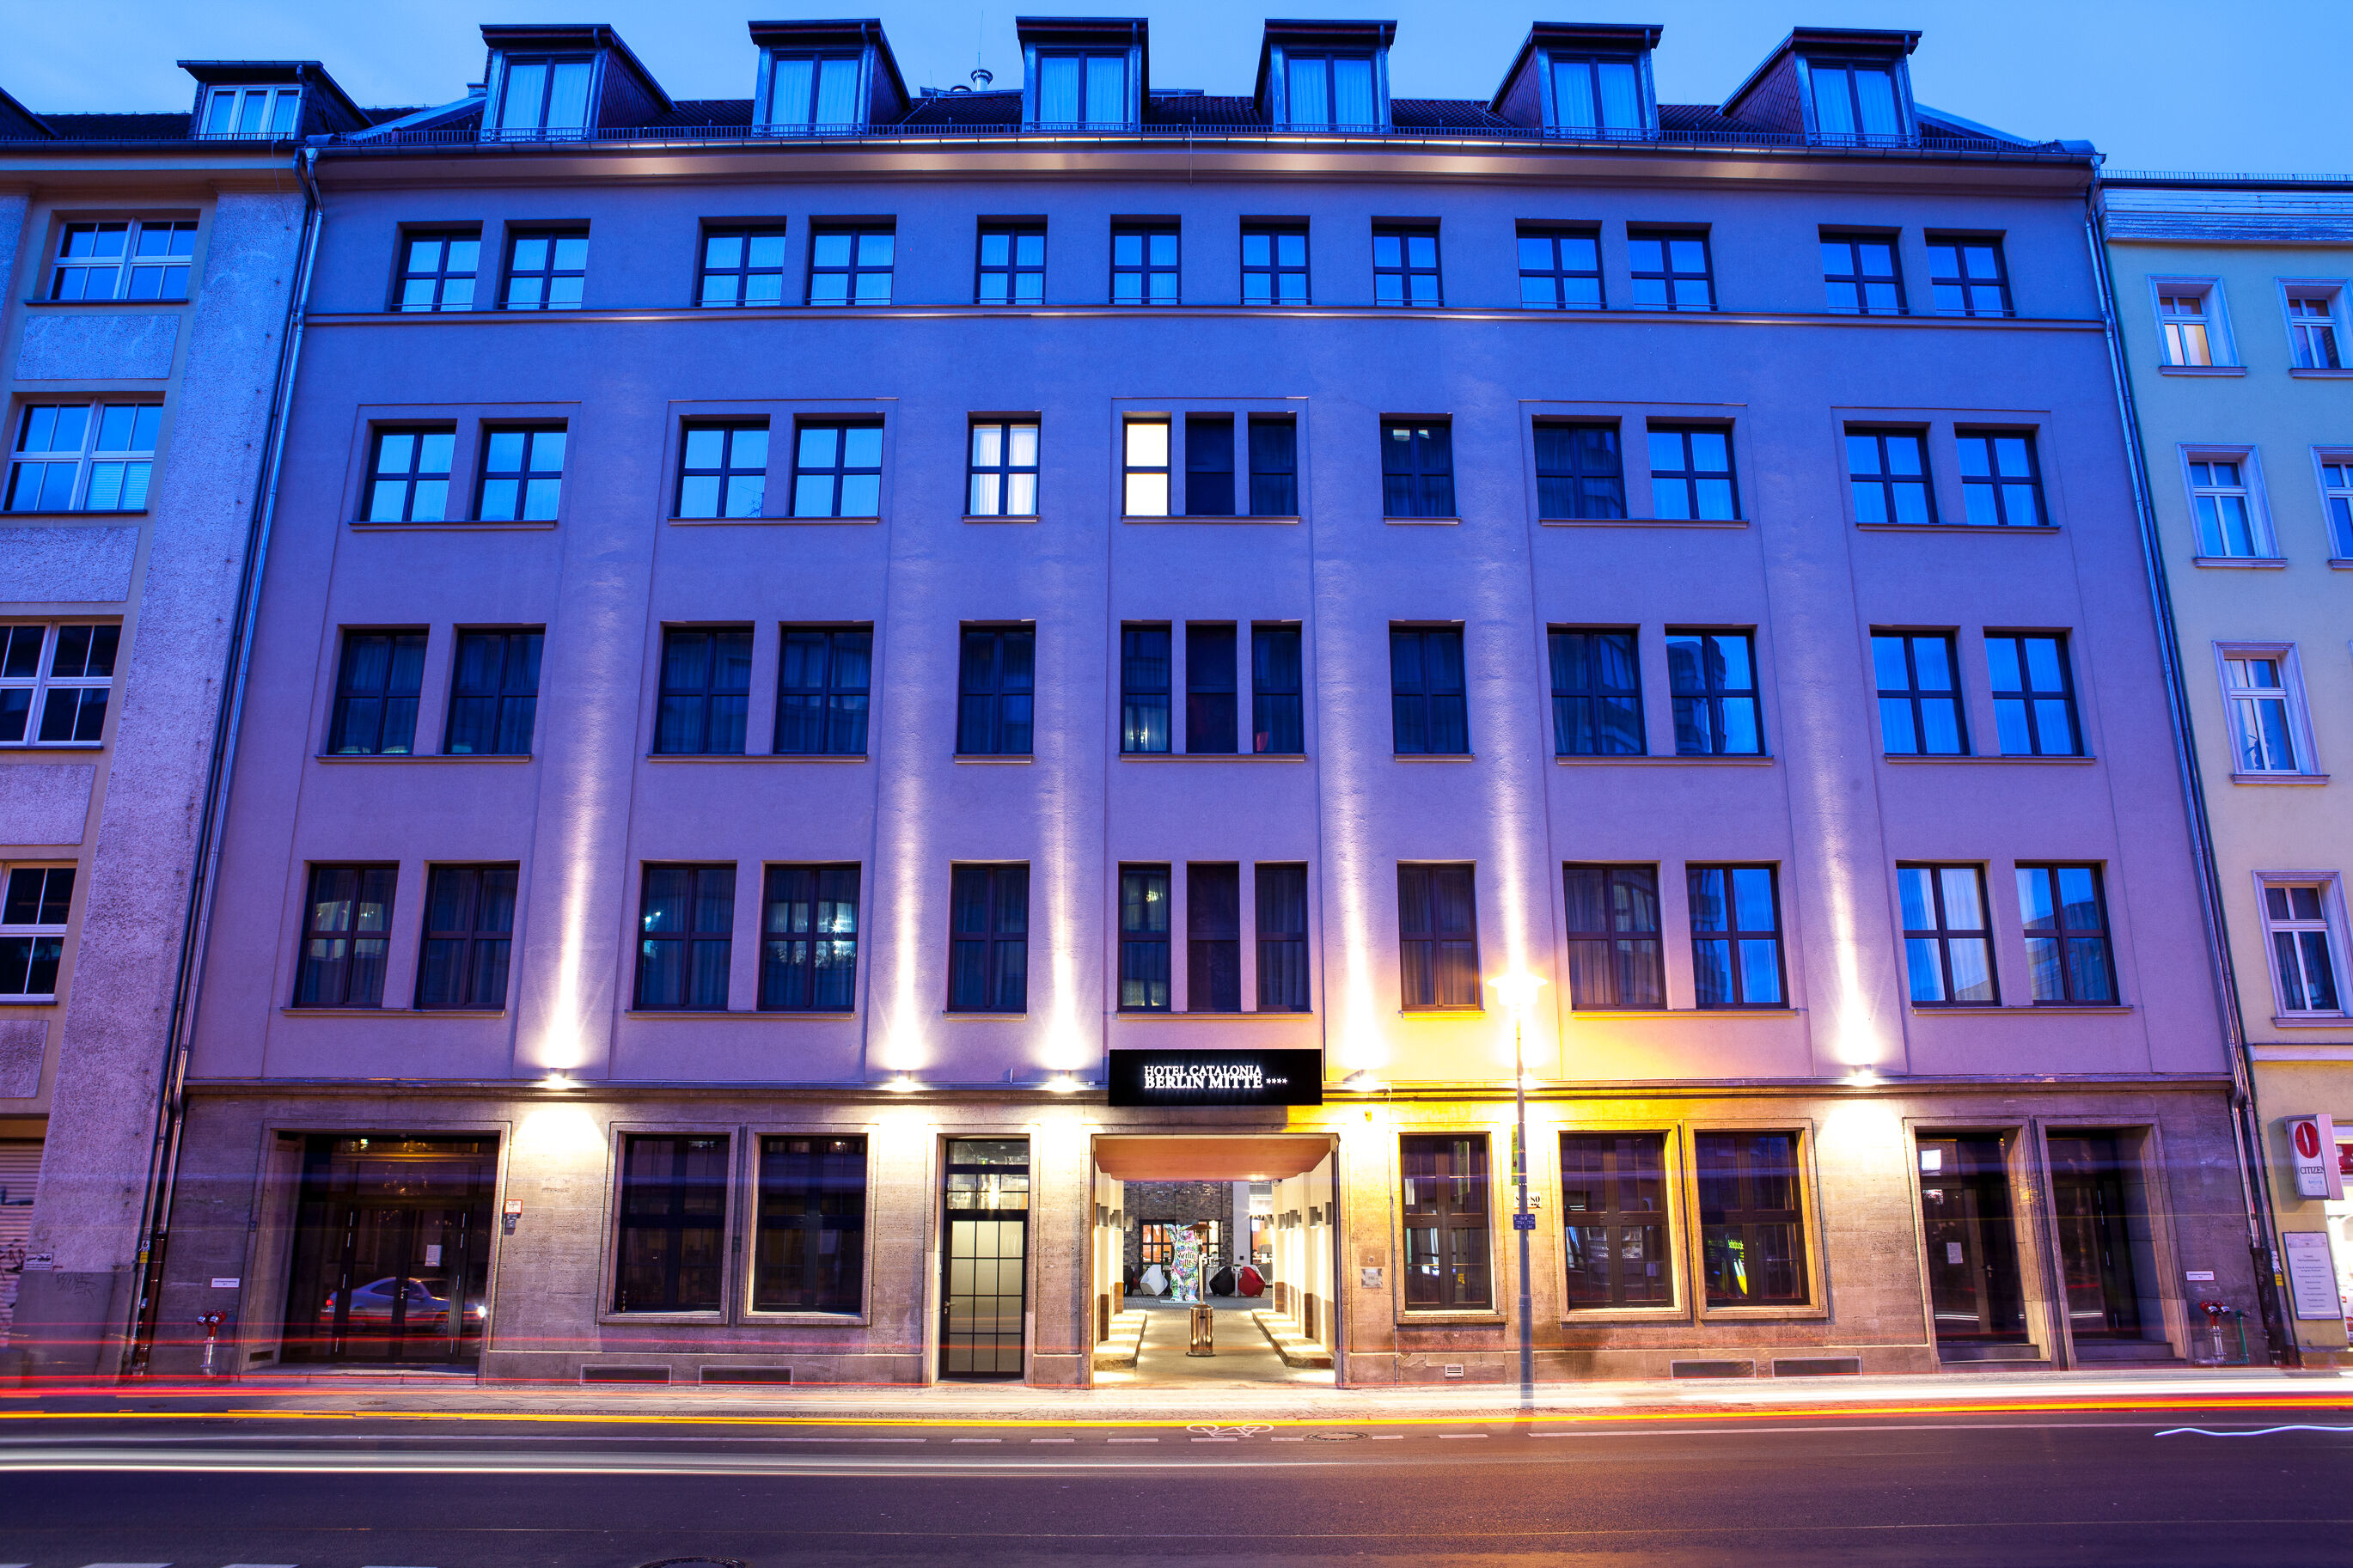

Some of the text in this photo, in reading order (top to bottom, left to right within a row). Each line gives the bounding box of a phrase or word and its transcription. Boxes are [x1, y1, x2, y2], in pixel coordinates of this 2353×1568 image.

[1144, 1065, 1262, 1077] HOTEL CATALONIA
[1144, 1075, 1263, 1089] BERLIN MITTE
[2300, 1166, 2325, 1174] CITIZEN
